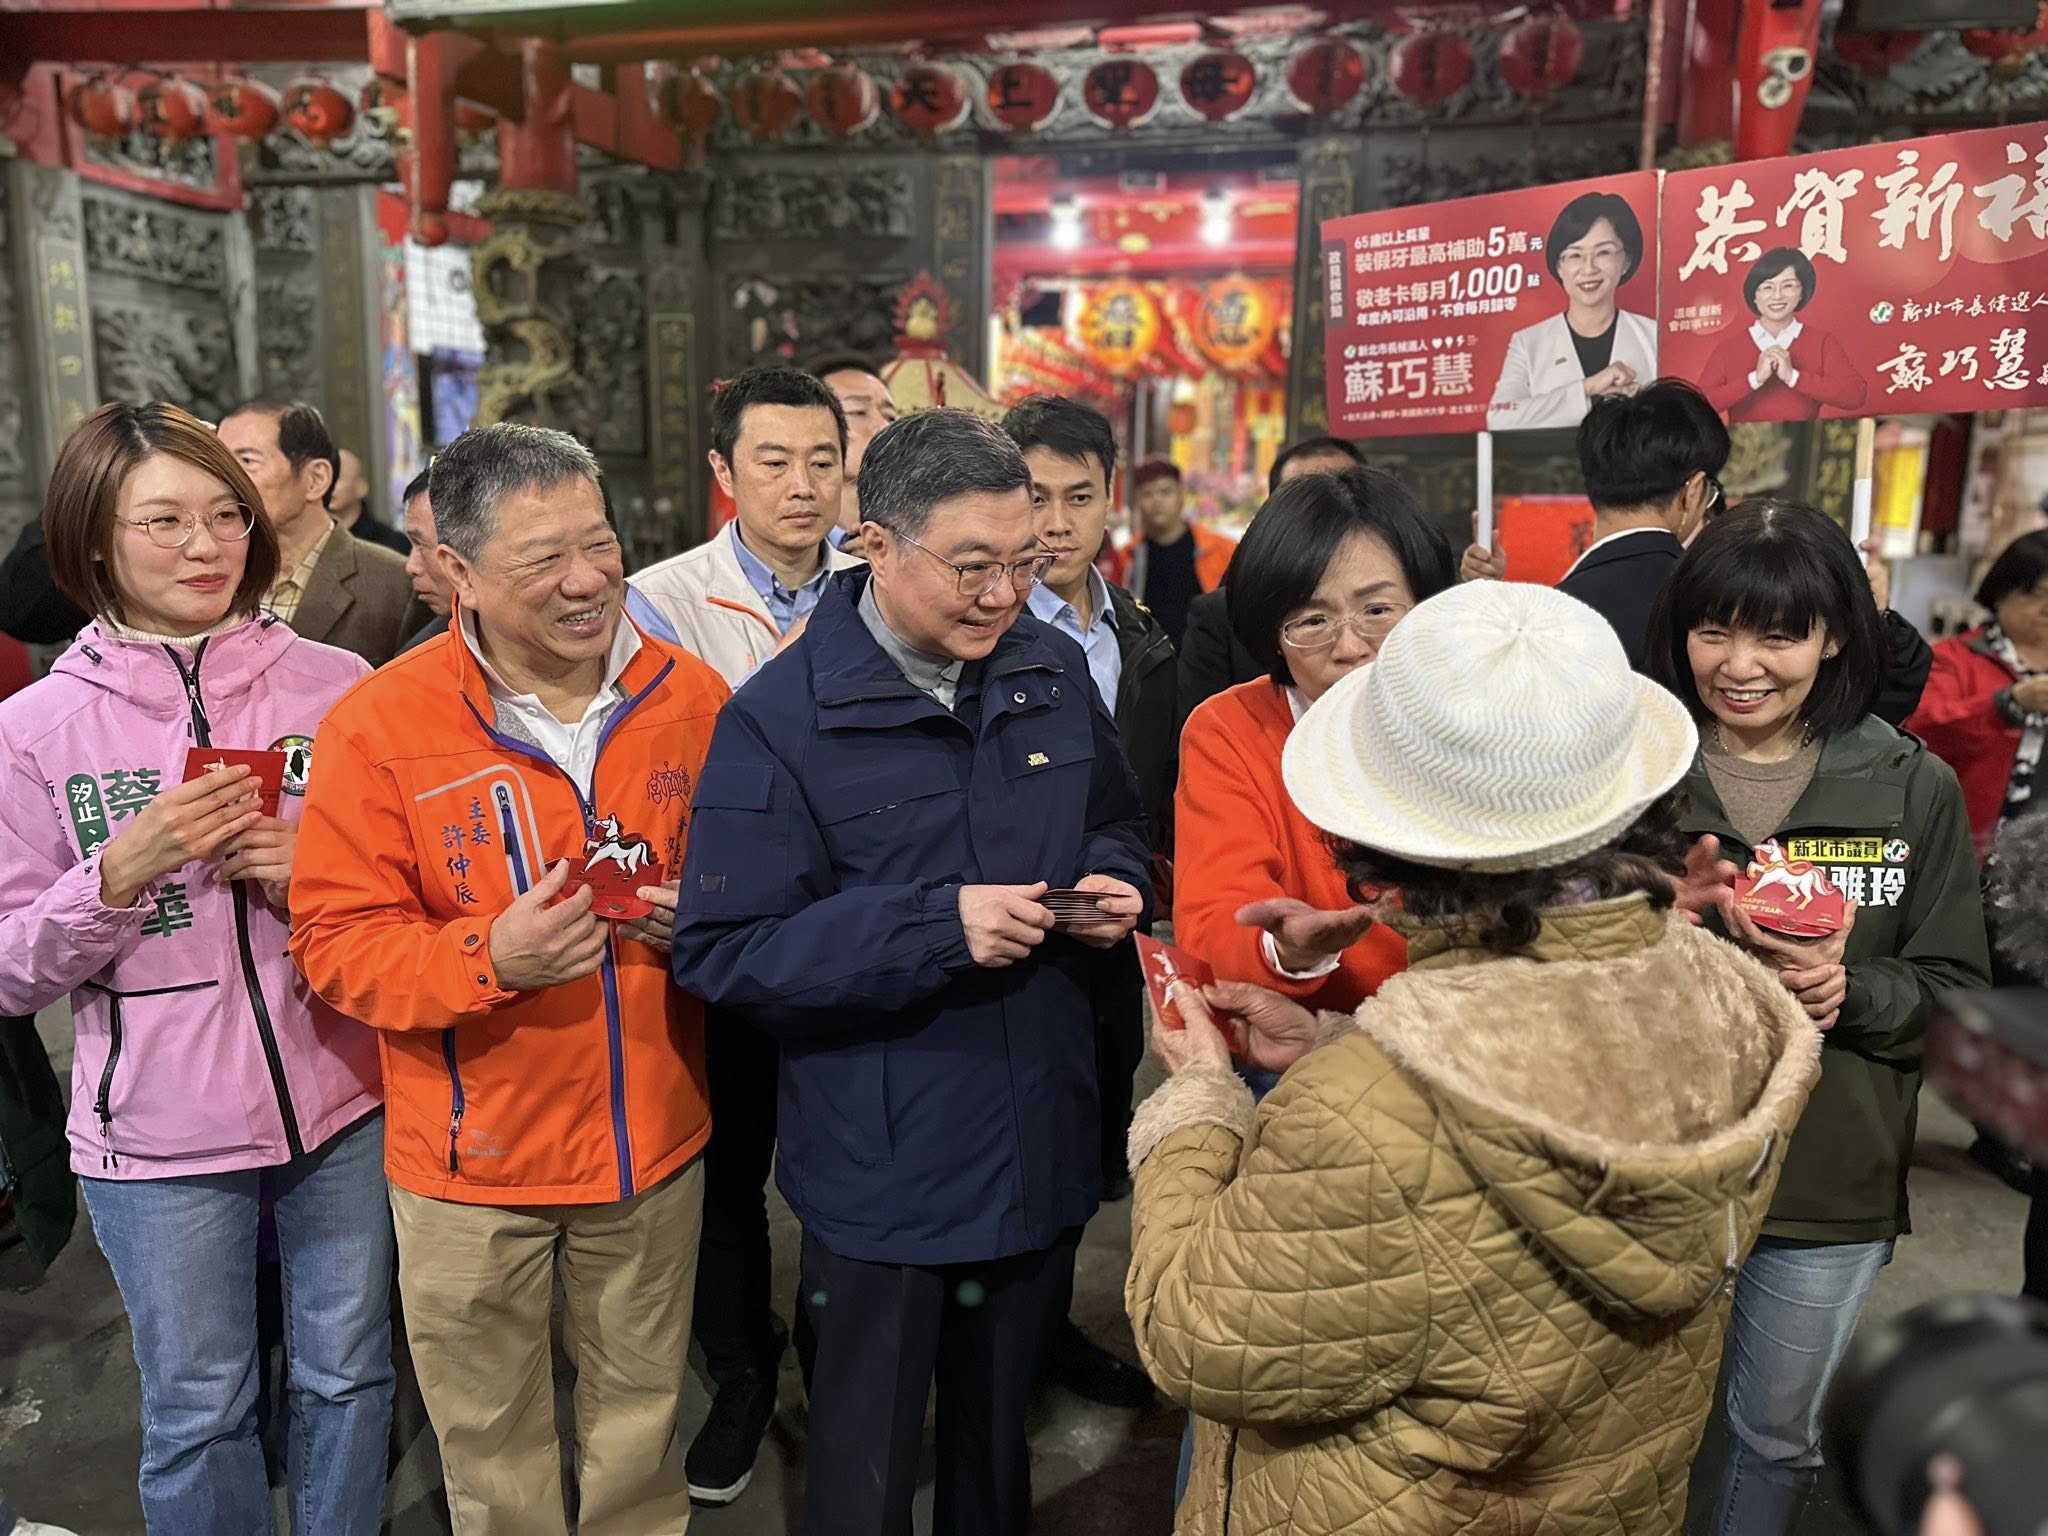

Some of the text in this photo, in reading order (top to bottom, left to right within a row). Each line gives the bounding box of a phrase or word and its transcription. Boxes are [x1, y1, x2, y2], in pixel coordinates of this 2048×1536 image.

[1901, 291, 2048, 322] 新北市長候選人
[1344, 352, 1473, 404] 蘇巧慧
[1875, 328, 2031, 394] 蘇巧慧
[468, 796, 491, 847] 主委
[101, 767, 194, 938] 蔡華
[441, 824, 481, 905] 許仲辰
[1793, 840, 1880, 859] 新北市議員
[1823, 866, 1906, 908] 雅玲
